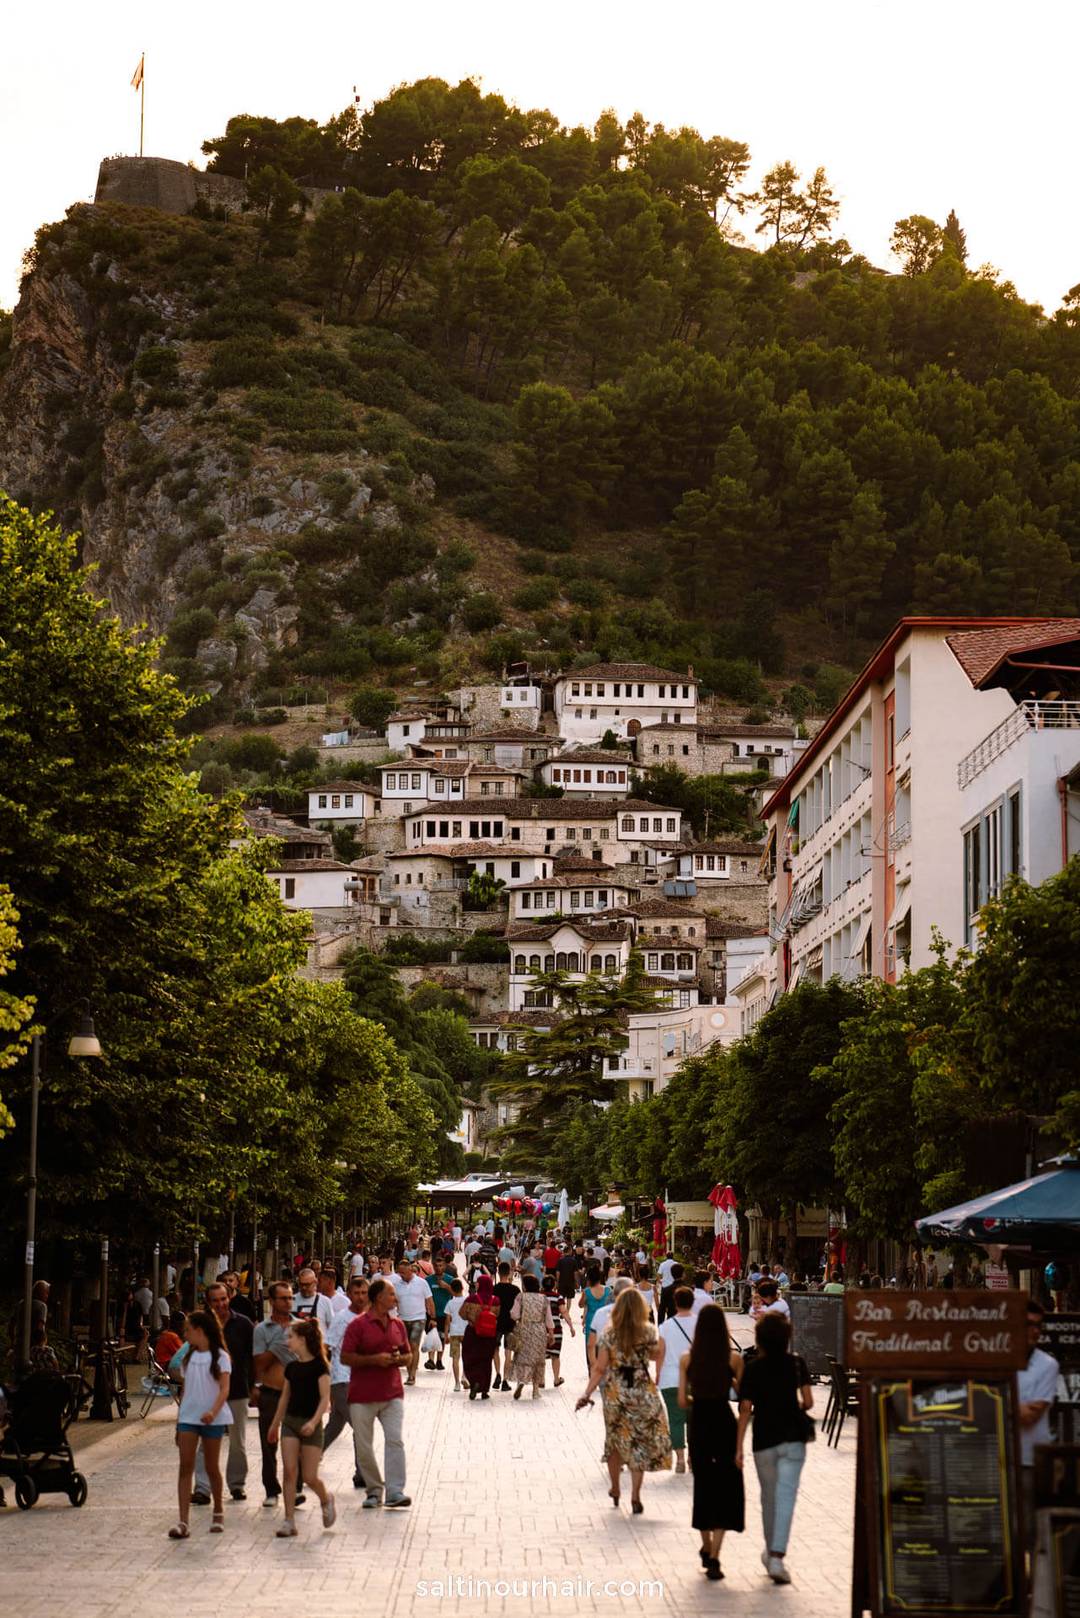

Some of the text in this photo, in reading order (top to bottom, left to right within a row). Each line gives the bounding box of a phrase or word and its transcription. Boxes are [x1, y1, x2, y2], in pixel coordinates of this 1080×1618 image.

[854, 1299, 1009, 1321] Bar Restaurant
[851, 1330, 1012, 1352] Traditional Grill
